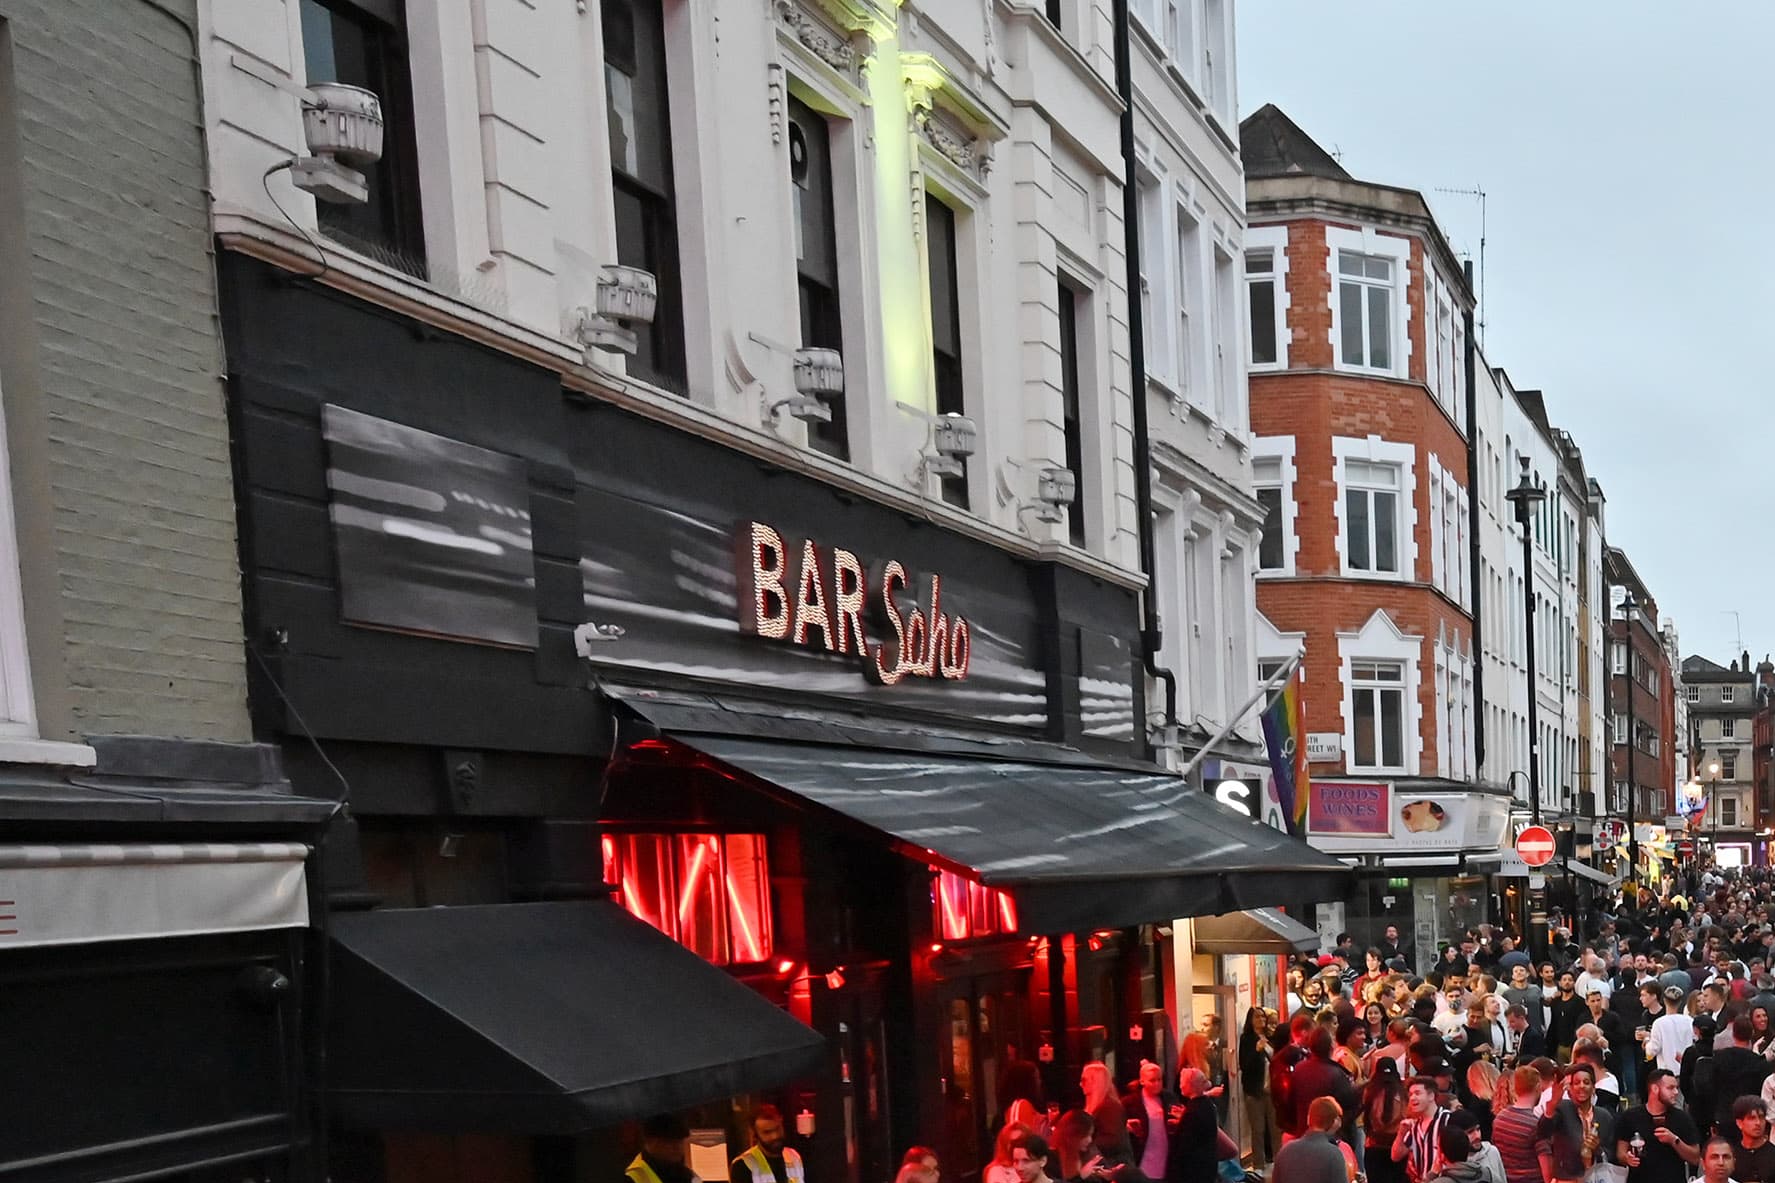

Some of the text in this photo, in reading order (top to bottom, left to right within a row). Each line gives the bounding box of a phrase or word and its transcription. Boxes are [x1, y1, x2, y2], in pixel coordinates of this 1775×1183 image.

[751, 520, 970, 686] BAR Soho
[1320, 788, 1381, 801] FOODS
[1322, 803, 1378, 817] WINES
